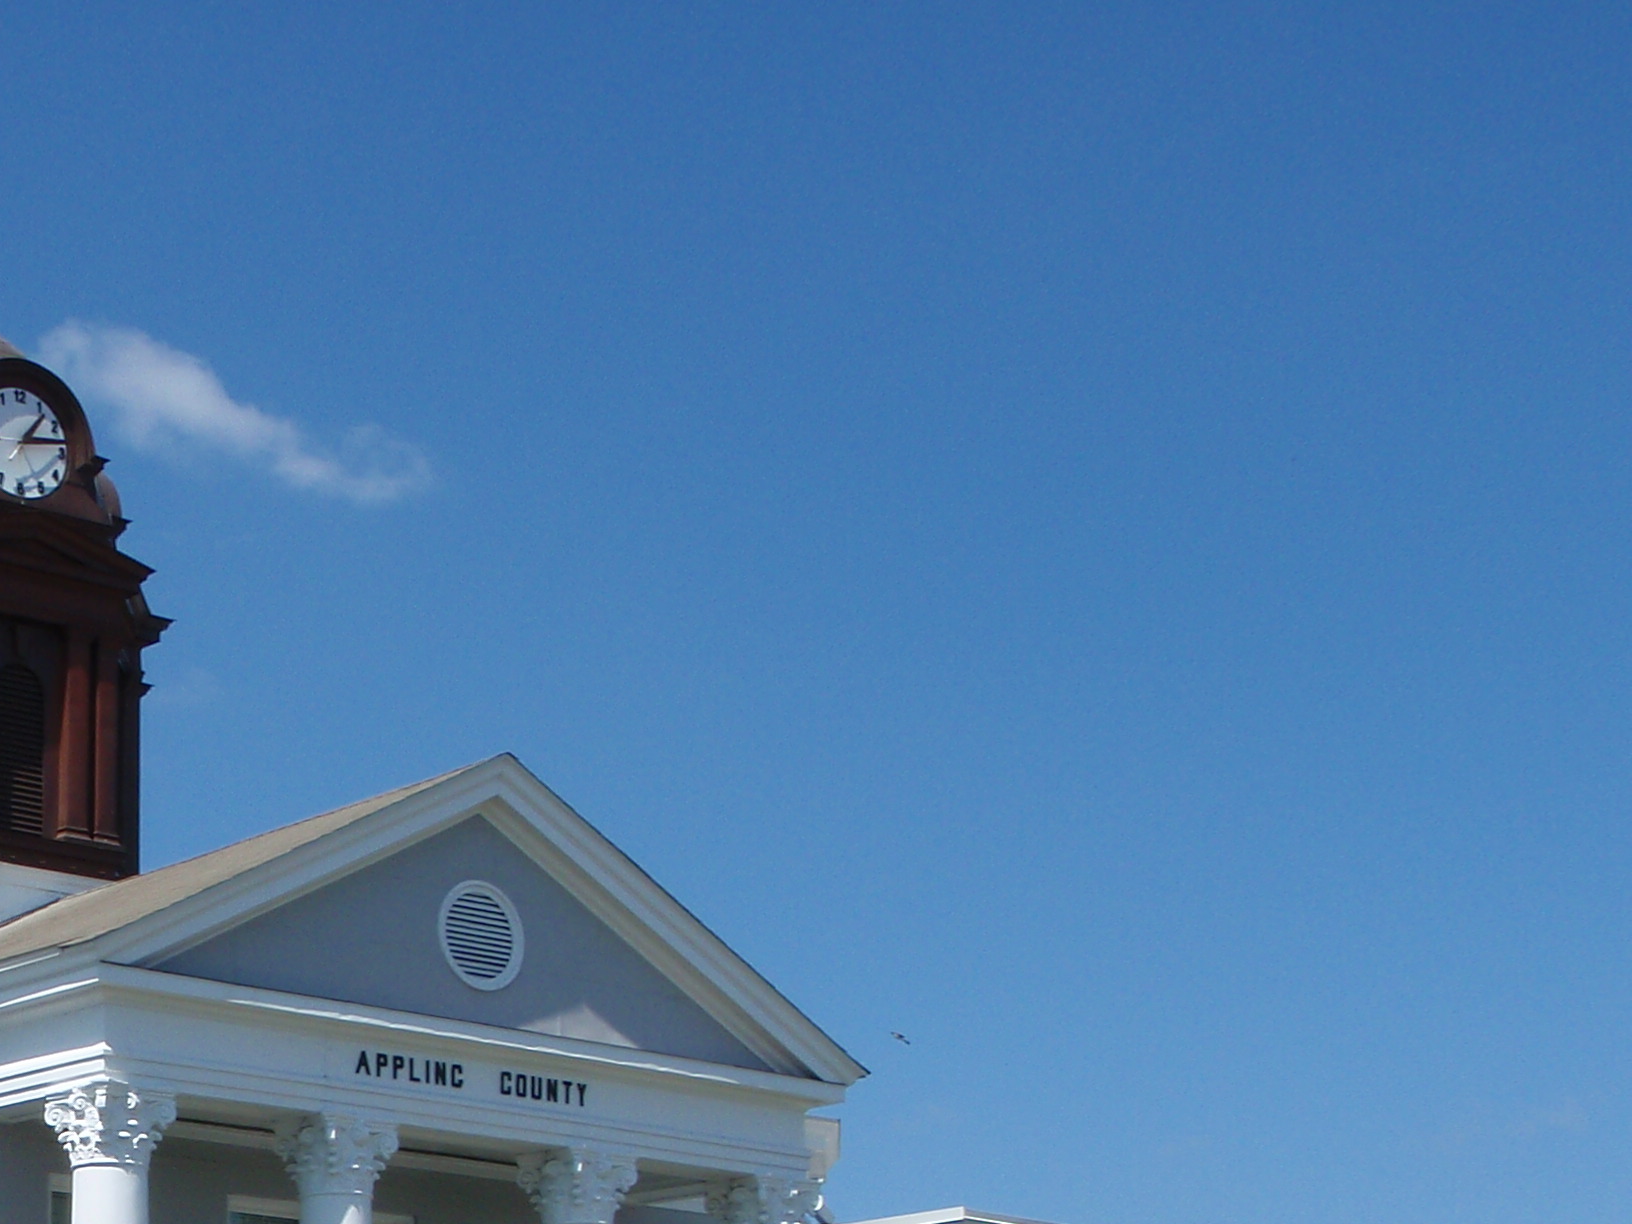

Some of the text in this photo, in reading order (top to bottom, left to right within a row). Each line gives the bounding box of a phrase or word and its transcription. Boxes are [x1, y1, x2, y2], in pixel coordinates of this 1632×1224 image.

[14, 389, 26, 405] 12
[37, 402, 42, 414] 1
[51, 420, 58, 434] 2
[58, 447, 65, 459] 3
[355, 1050, 587, 1107] APPLING COUNTY
